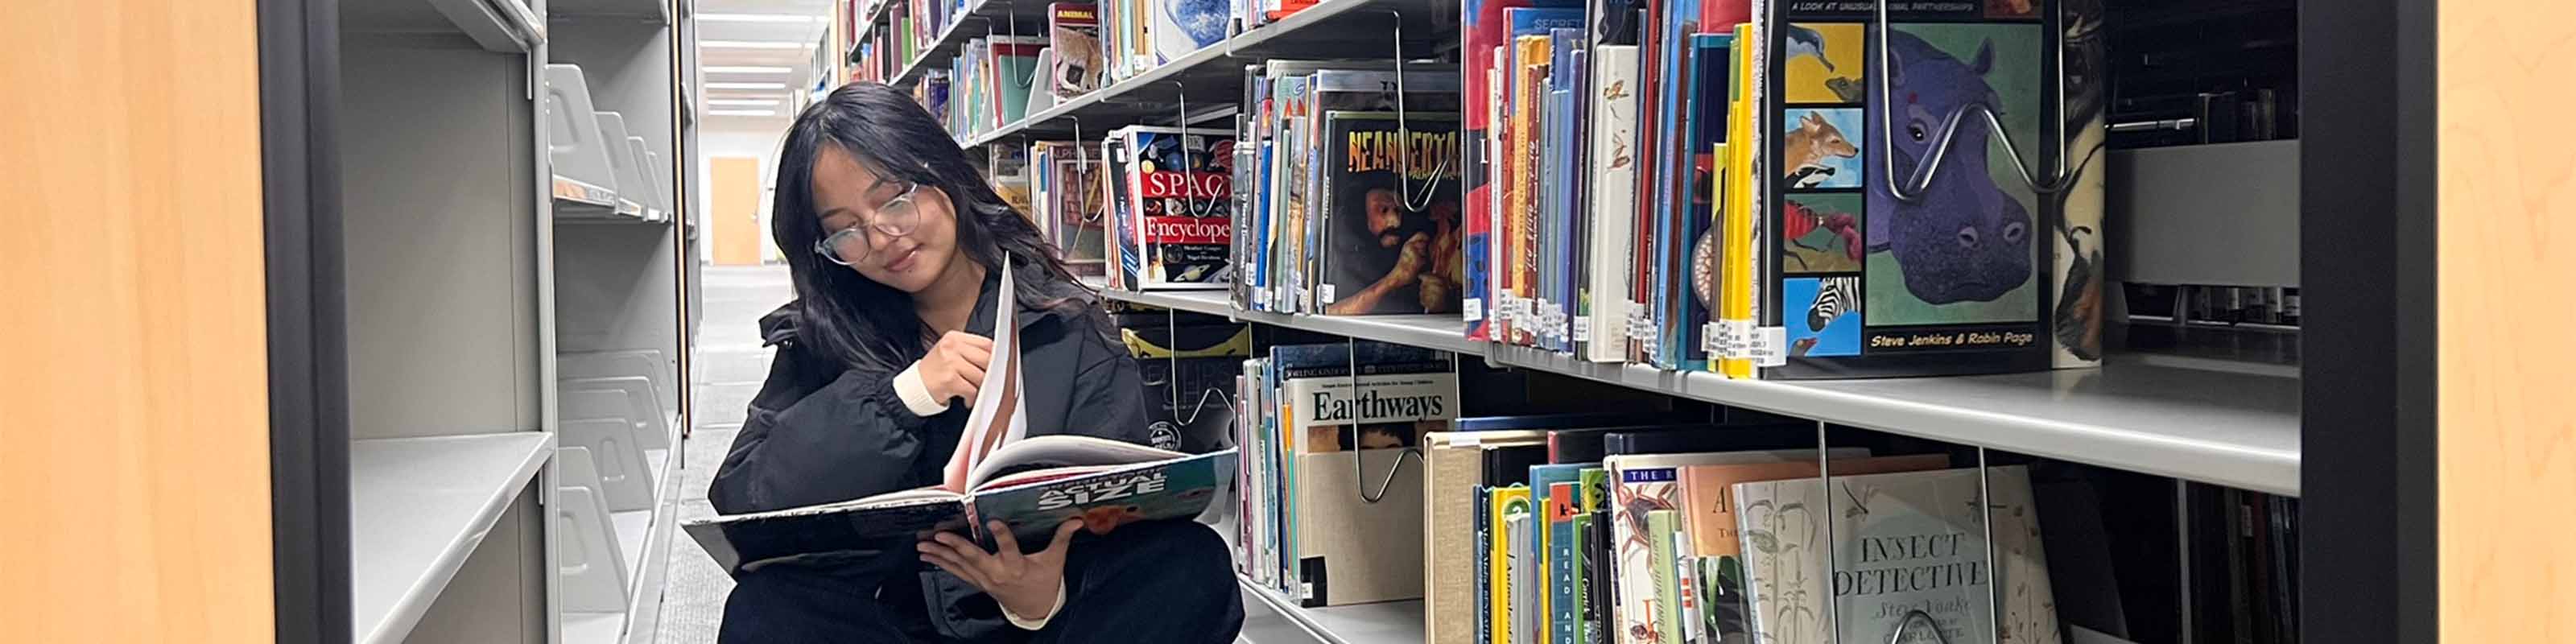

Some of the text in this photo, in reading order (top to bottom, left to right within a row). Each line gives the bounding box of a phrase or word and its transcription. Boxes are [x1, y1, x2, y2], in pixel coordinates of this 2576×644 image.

[1057, 10, 1094, 19] ANIMAL
[1800, 3, 1824, 11] LOOK
[1825, 3, 1838, 11] AT
[1348, 129, 1461, 179] NEANDERTA
[1150, 173, 1232, 198] SPAC
[1871, 332, 2033, 346] Steve Jenkins & Robin Page
[1313, 390, 1443, 423] Earthways
[1039, 473, 1166, 499] ACTUAL
[1631, 470, 1658, 481] THE
[1038, 478, 1166, 510] SIZE
[1712, 485, 1728, 514] A
[1861, 532, 1965, 563] INSECT
[1835, 560, 1988, 597] DETECTIVE
[1564, 612, 1572, 644] AND
